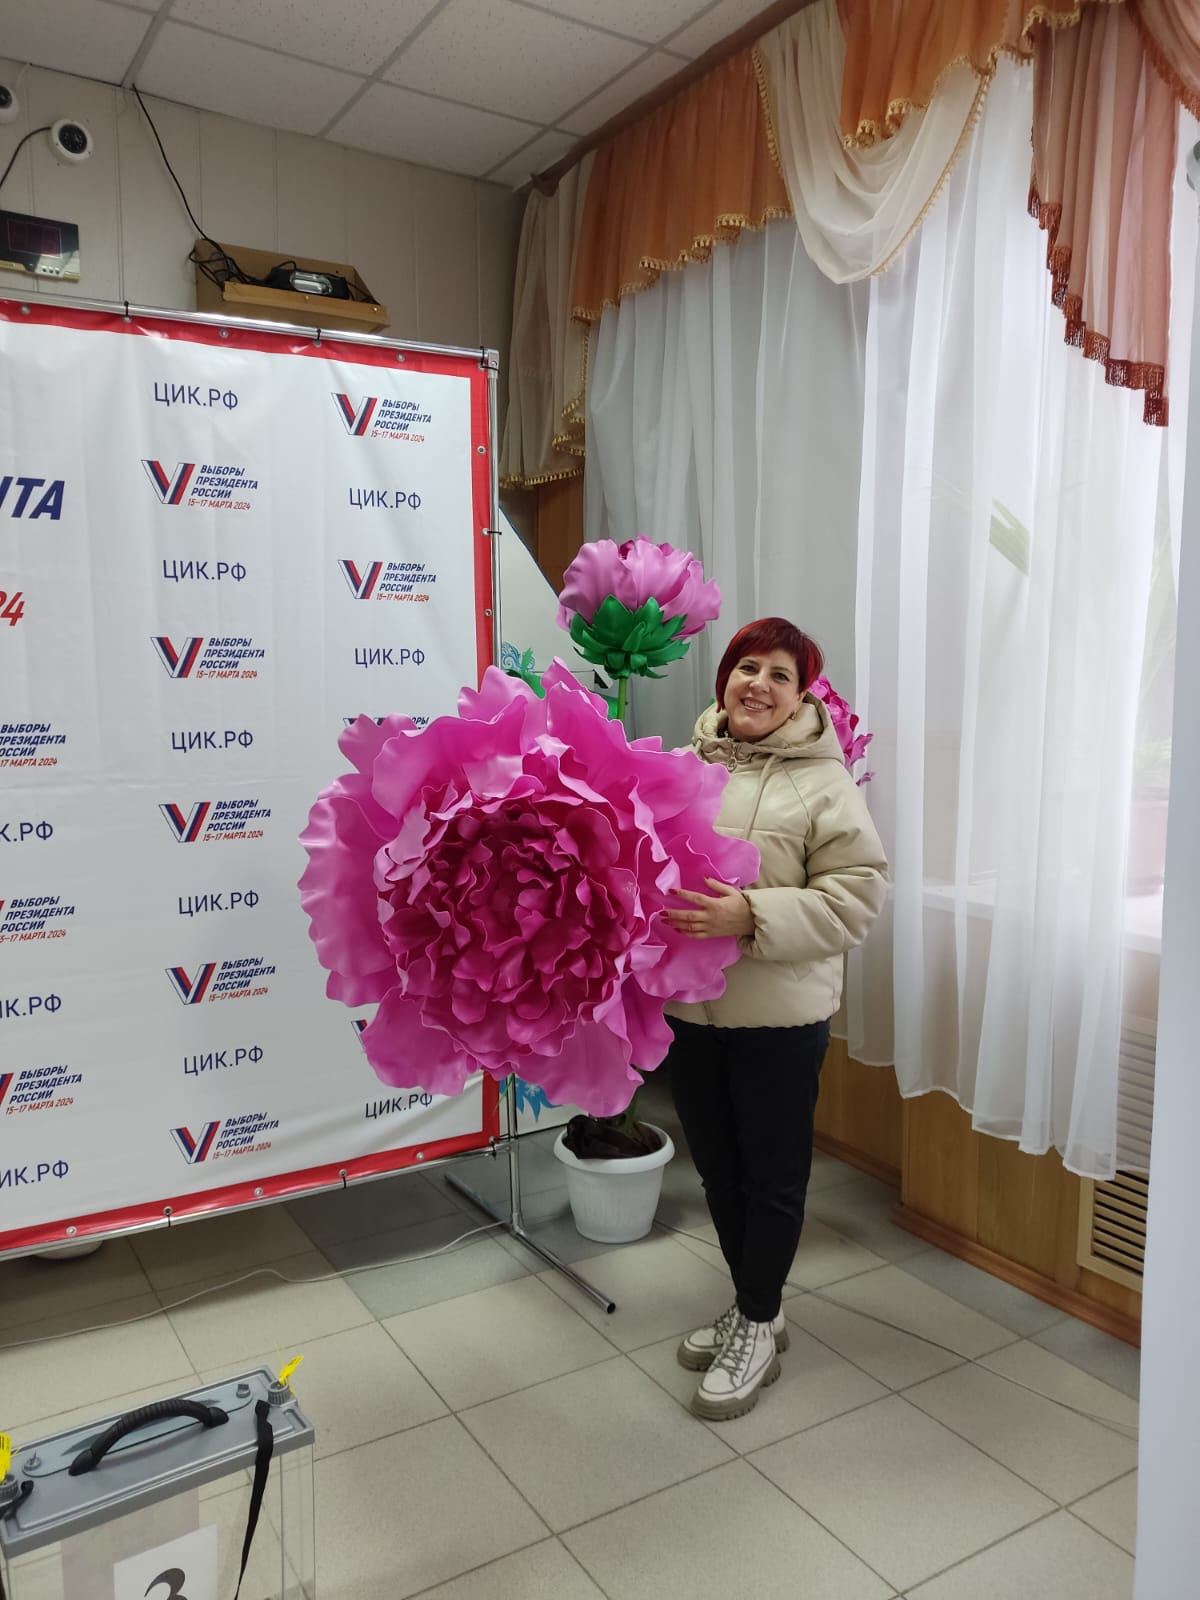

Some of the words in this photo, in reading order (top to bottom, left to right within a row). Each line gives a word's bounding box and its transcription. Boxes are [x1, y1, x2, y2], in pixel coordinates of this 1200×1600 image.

[154, 382, 238, 410] ЦИК.РФ
[382, 399, 420, 411] ВЫБОРЫ
[378, 409, 432, 423] ПРЕЗИДЕНТА
[374, 419, 410, 431] РОССИИ
[389, 430, 410, 441] МАРТА
[410, 433, 425, 443] 2024
[200, 464, 246, 477] ВЫБОРЫ
[195, 476, 259, 489] ПРЕЗИДЕНТА
[0, 476, 65, 520] ТА
[191, 487, 232, 499] РОССИИ
[349, 487, 422, 510] ЦИК.РФ
[208, 499, 233, 509] МАРТА
[233, 501, 251, 510] 2024
[163, 559, 247, 582] ЦИК.РФ
[386, 562, 426, 572] ВЫБОРЫ
[383, 572, 437, 583] ПРЕЗИДЕНТА
[379, 583, 413, 593] РОССИИ
[393, 593, 413, 601] МАРТА
[413, 594, 430, 602] 2024
[208, 637, 253, 647] ВЫБОРЫ
[203, 649, 265, 659] ПРЕЗИДЕНТА
[354, 648, 425, 668] ЦИК.РФ
[199, 660, 240, 669] РОССИИ
[216, 670, 240, 679] МАРТА
[240, 670, 258, 679] 2024
[0, 723, 51, 733] ВЫБОРЫ
[171, 730, 253, 753] ЦИК.РФ
[9, 758, 37, 767] МАРТА
[38, 757, 58, 766] 2024
[215, 799, 259, 810] ВЫБОРЫ
[210, 808, 271, 821] ПРЕЗИДЕНТА
[206, 821, 246, 831] РОССИИ
[223, 831, 247, 841] МАРТА
[246, 830, 264, 839] 2024
[10, 895, 61, 909] ВЫБОРЫ
[178, 890, 259, 917] ЦИК.РФ
[5, 906, 75, 921] ПРЕЗИДЕНТА
[0, 920, 46, 933] РОССИИ
[19, 931, 46, 941] МАРТА
[47, 929, 67, 939] 2024
[221, 956, 264, 970] ВЫБОРЫ
[216, 966, 276, 981] ПРЕЗИДЕНТА
[211, 979, 251, 992] РОССИИ
[228, 989, 251, 999] МАРТА
[251, 987, 269, 996] 2024
[0, 993, 62, 1019] К.РФ
[183, 1046, 263, 1077] ЦИК.РФ
[19, 1065, 68, 1081] ВЫБОРЫ
[14, 1073, 82, 1092] ПРЕЗИДЕНТА
[9, 1089, 54, 1104] РОССИИ
[27, 1100, 54, 1112] МАРТА
[55, 1097, 74, 1107] 2024
[365, 1093, 433, 1119] ЦИК.РФ
[225, 1112, 268, 1128] ВЫБОРЫ
[220, 1120, 279, 1139] ПРЕЗИДЕНТА
[215, 1134, 255, 1150] РОССИИ
[231, 1145, 255, 1156] МАРТА
[255, 1141, 272, 1152] 2024
